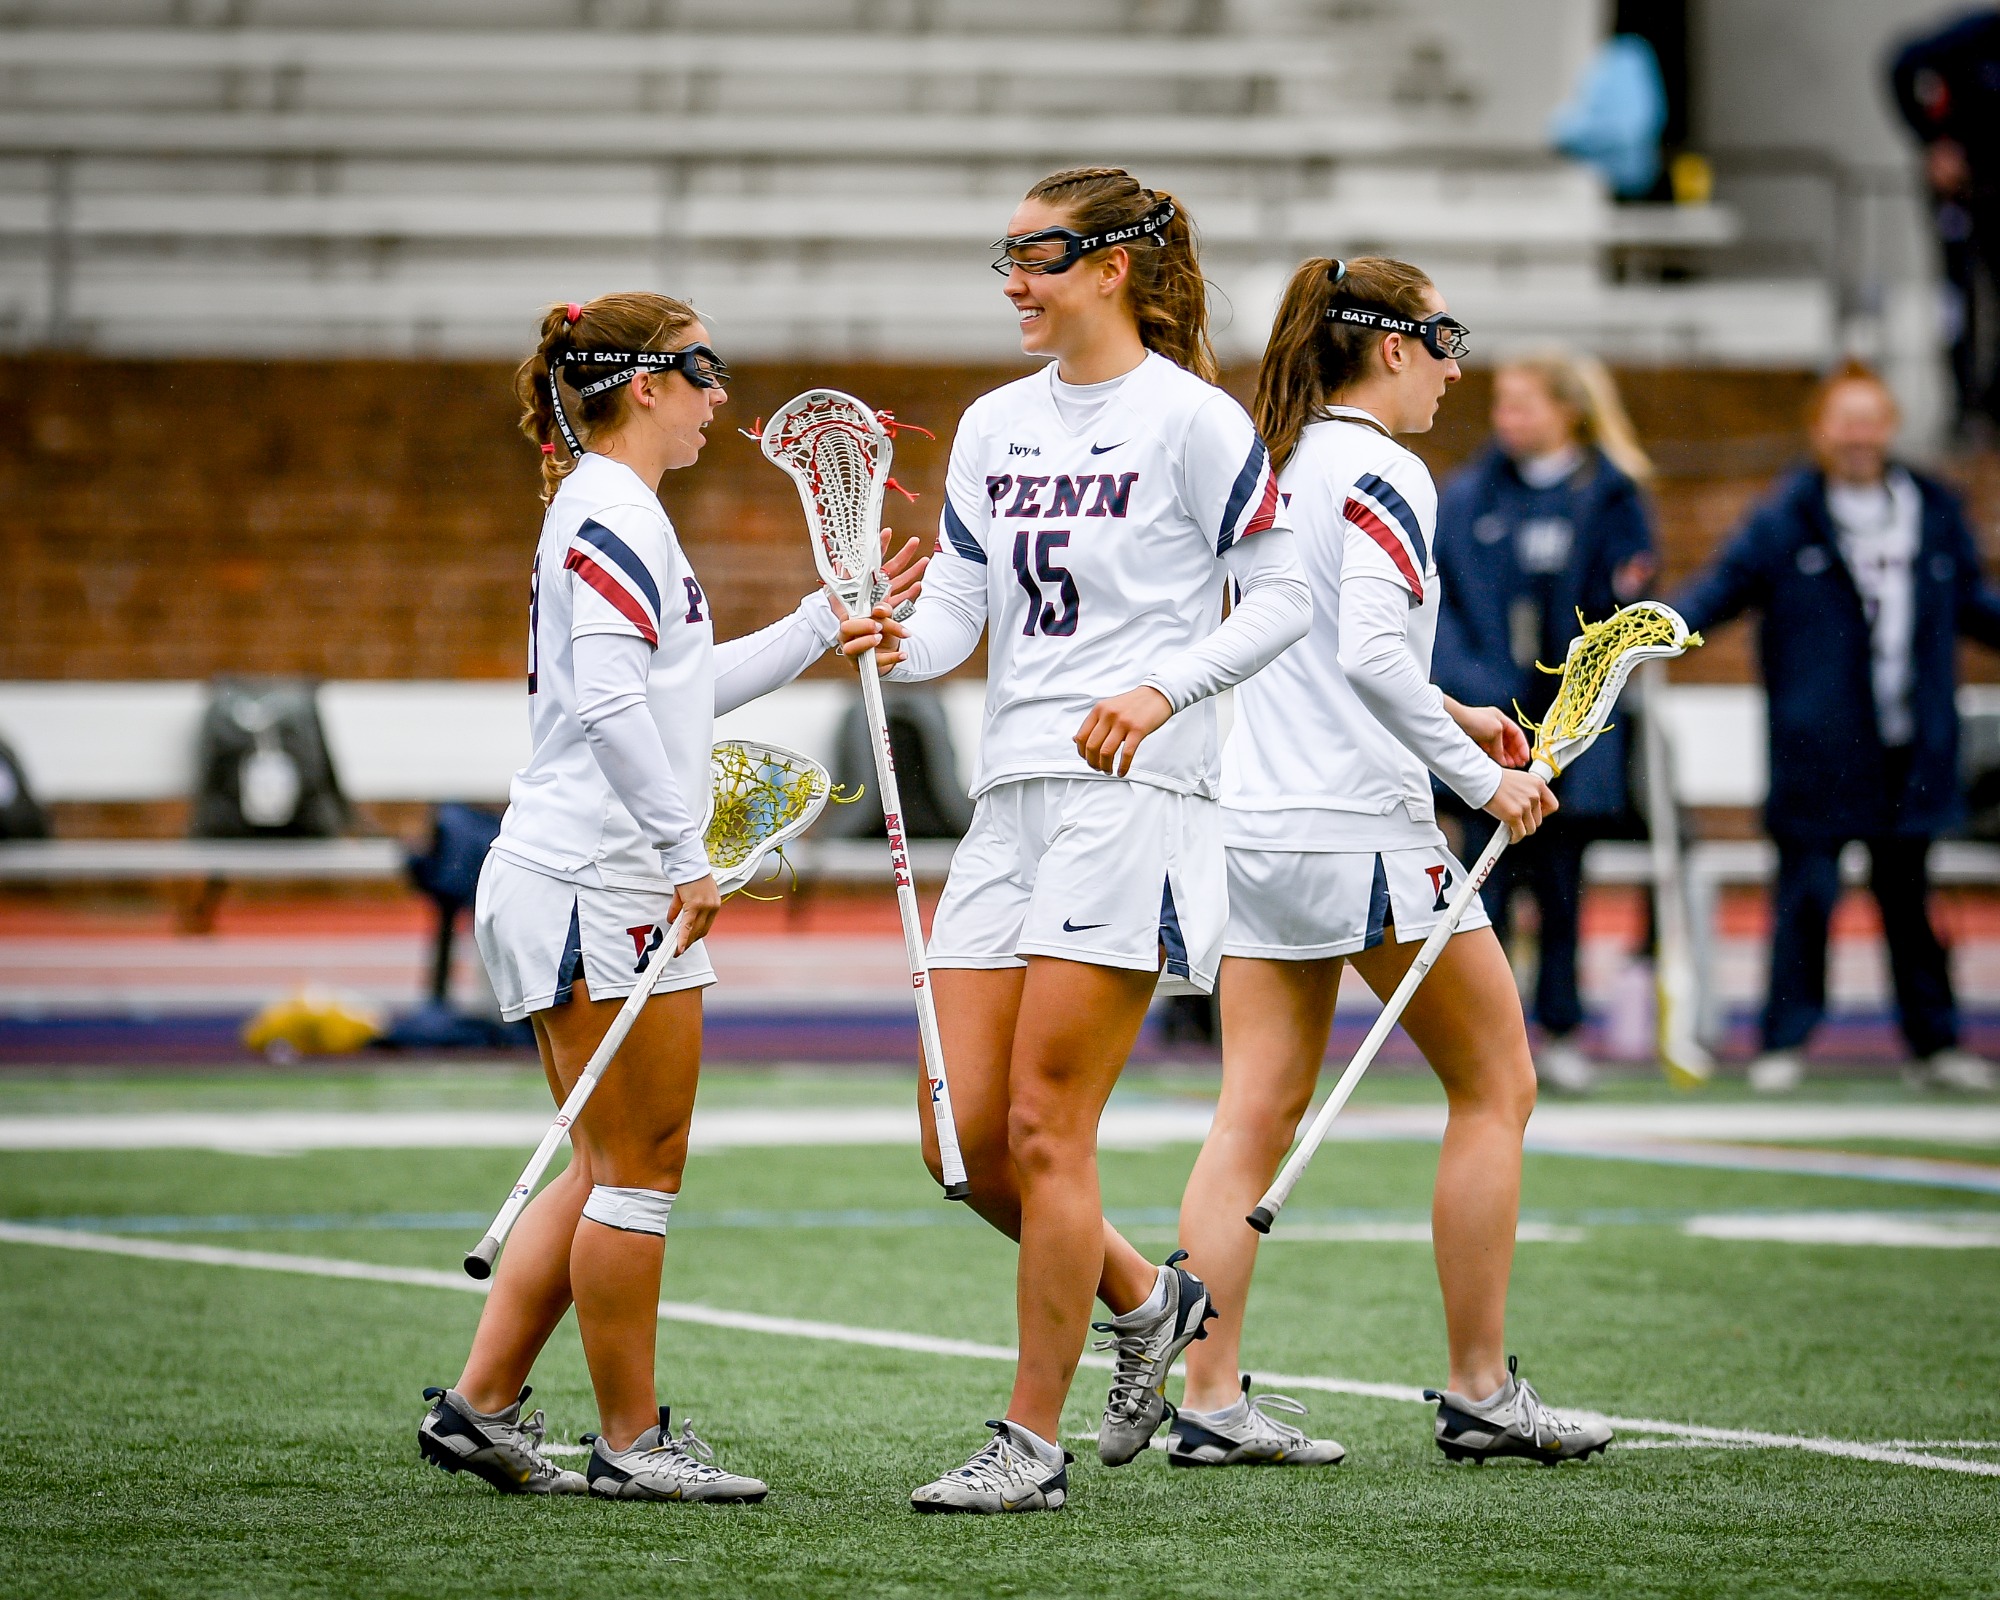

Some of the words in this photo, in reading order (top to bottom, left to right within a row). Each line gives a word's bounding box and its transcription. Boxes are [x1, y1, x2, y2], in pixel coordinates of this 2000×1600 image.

[1105, 226, 1140, 243] GAIT
[1341, 311, 1376, 325] GAIT
[1380, 317, 1415, 332] GAIT
[594, 352, 631, 363] GAIT
[637, 354, 676, 364] GAIT
[1008, 442, 1032, 458] Ivy
[985, 472, 1140, 519] PENN
[1012, 530, 1080, 637] 15
[884, 813, 911, 888] PENN
[1471, 856, 1496, 895] GAIT
